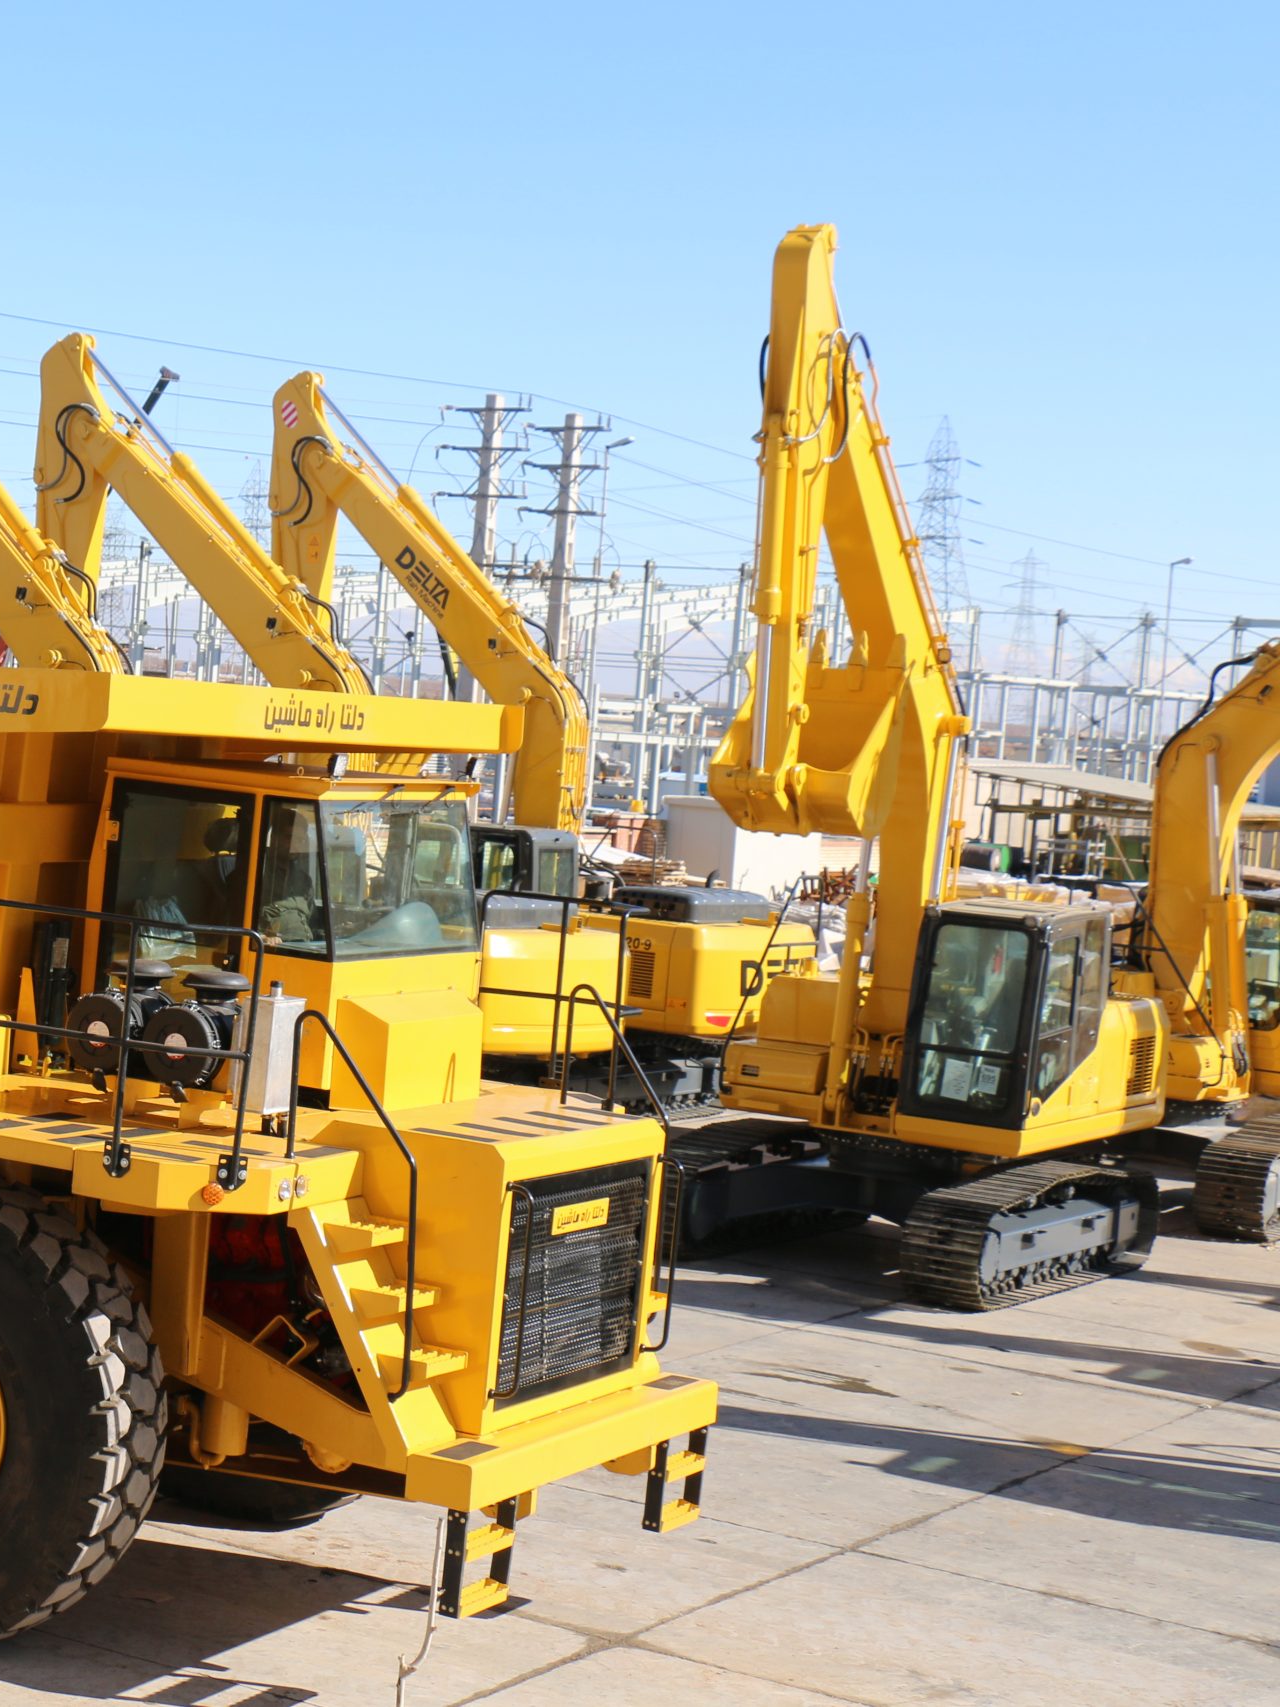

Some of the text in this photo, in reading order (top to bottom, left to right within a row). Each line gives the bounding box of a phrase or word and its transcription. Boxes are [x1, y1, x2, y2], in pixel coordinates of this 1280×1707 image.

[395, 545, 449, 610] DELTA
[264, 693, 365, 734] دلتا راه ماشین
[556, 1205, 605, 1230] دلتا راه ماشین
